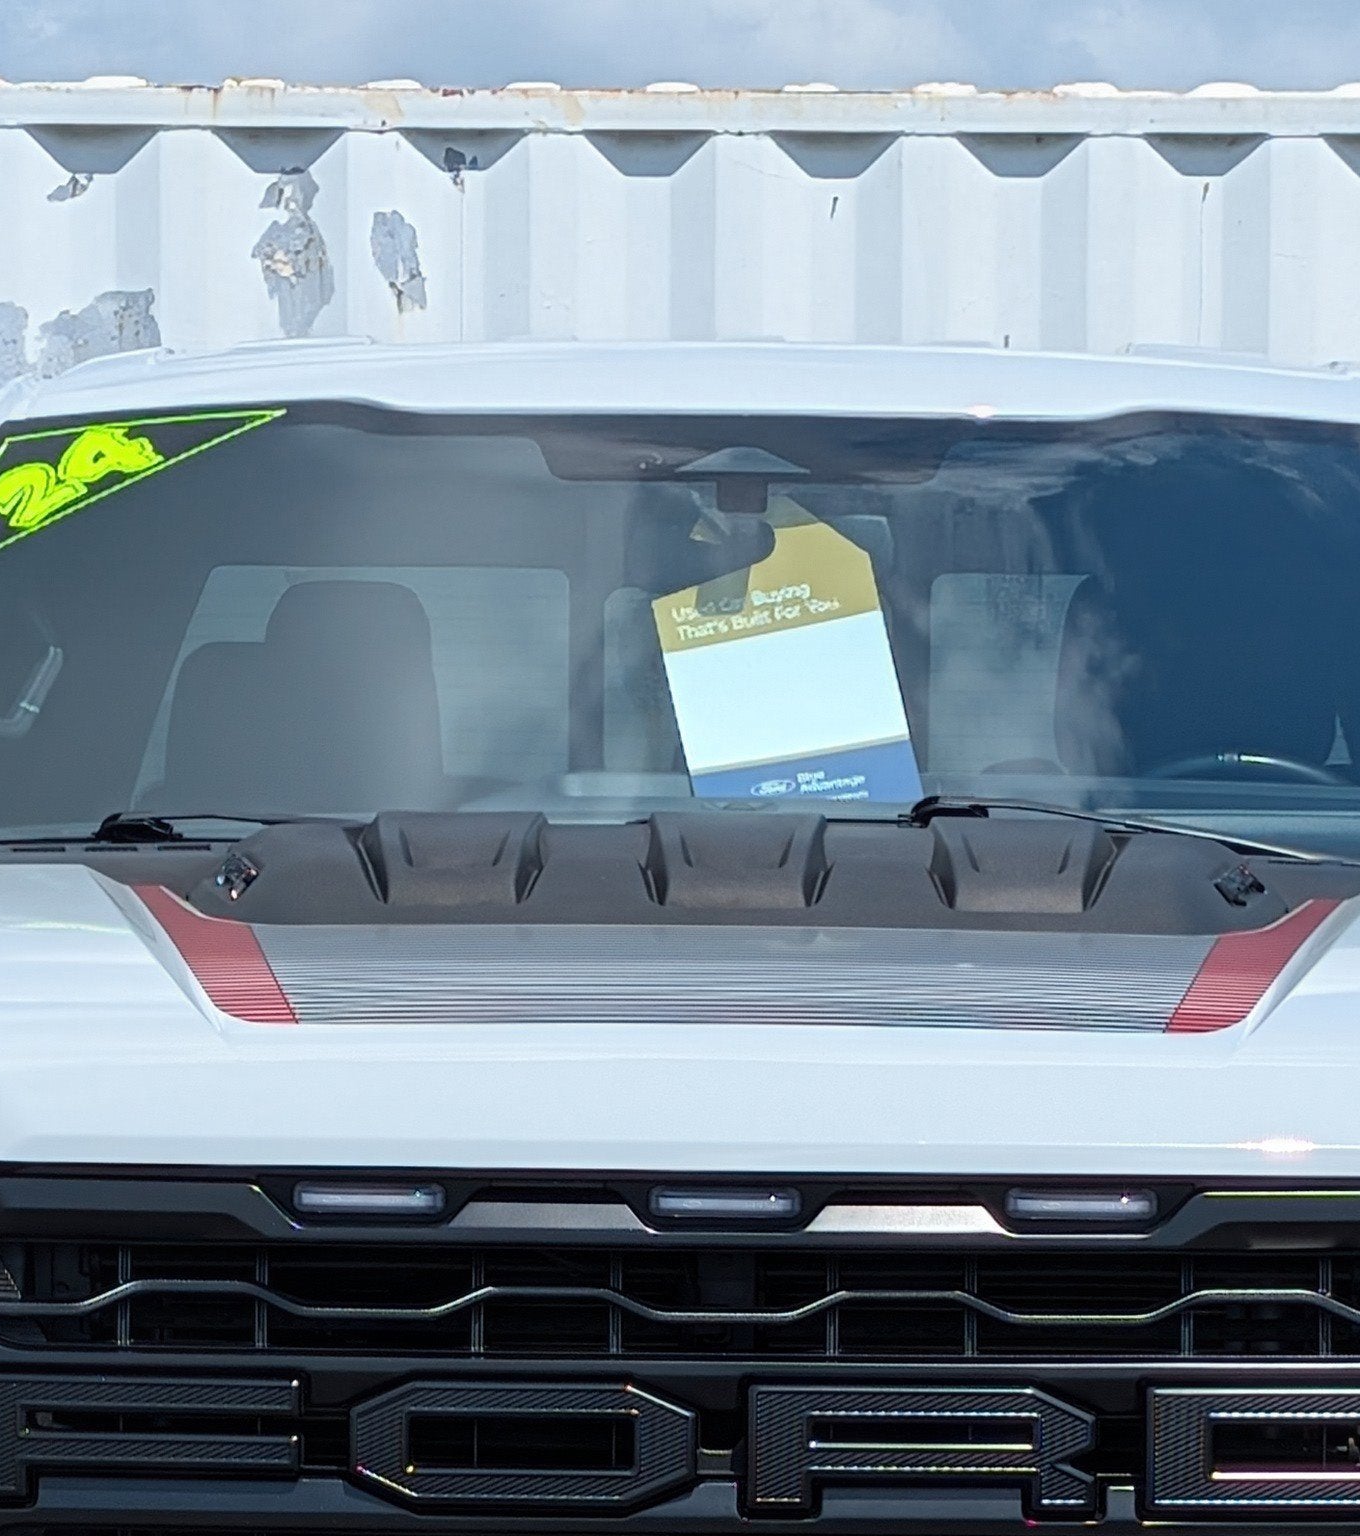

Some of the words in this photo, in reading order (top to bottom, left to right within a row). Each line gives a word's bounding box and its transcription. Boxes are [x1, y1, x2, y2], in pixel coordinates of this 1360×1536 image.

[750, 583, 811, 606] Buying
[676, 619, 729, 641] That's
[731, 610, 772, 631] Built
[774, 603, 802, 620] For
[805, 597, 840, 613] You
